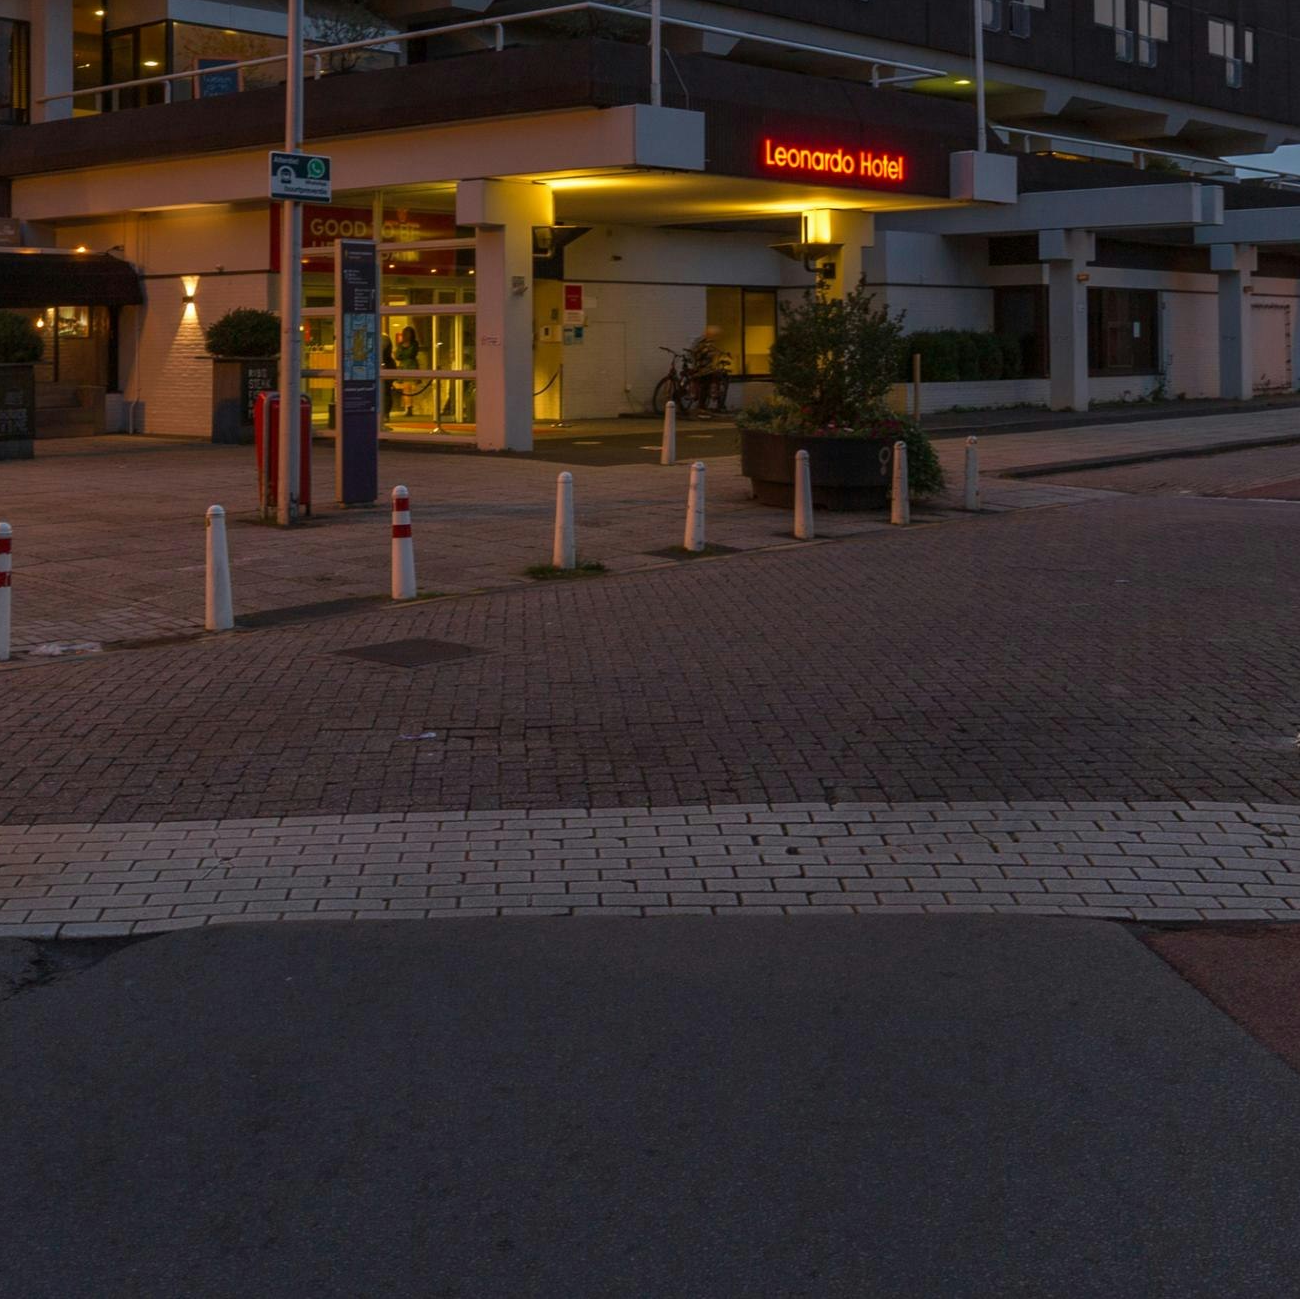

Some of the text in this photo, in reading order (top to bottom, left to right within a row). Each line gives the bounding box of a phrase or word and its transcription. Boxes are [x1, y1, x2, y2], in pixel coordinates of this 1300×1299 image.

[766, 139, 904, 181] Leonardo Hotel
[310, 219, 367, 238] GOOD
